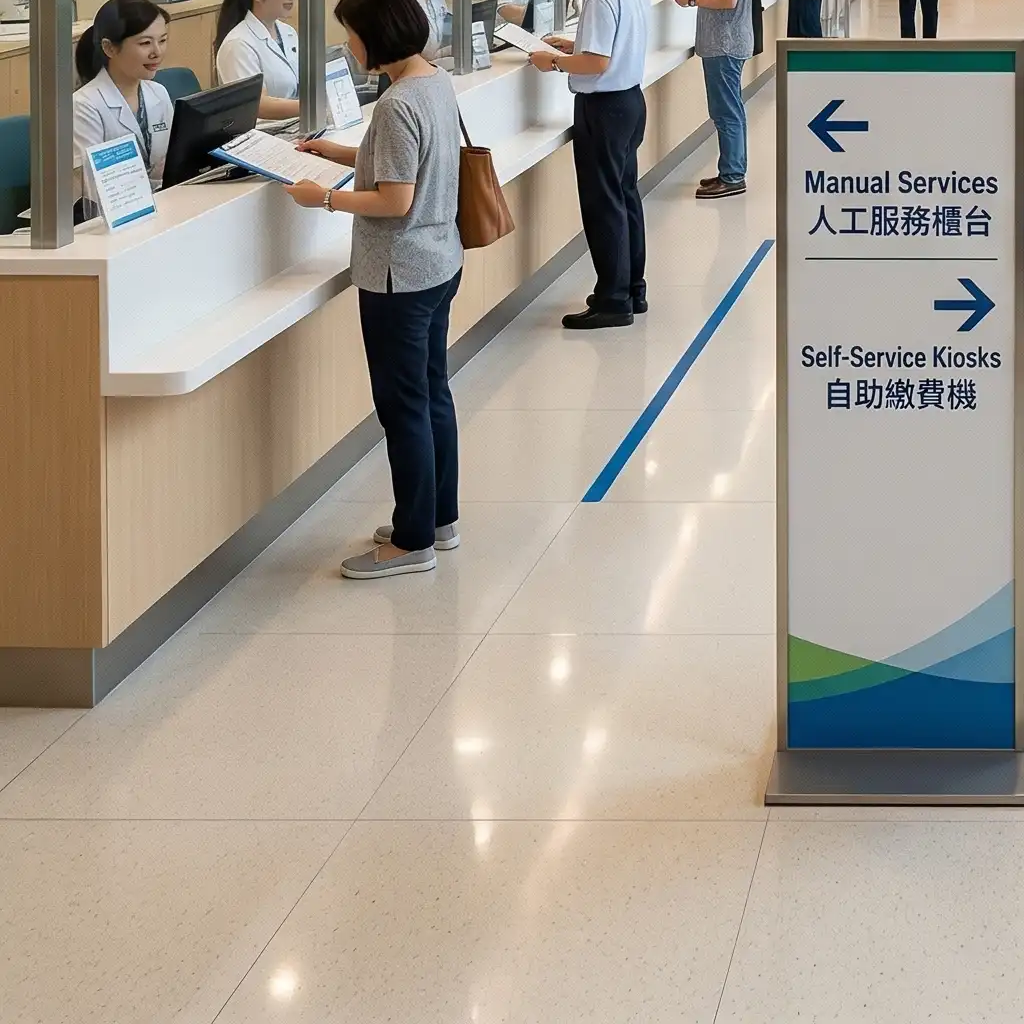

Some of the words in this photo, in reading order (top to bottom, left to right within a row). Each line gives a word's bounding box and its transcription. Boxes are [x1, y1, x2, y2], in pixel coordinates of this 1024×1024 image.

[805, 169, 890, 195] Manual
[897, 170, 999, 195] Services
[807, 204, 992, 238] 人工服務櫃台
[801, 344, 927, 369] Self-Service
[932, 345, 1002, 369] Kiosks
[826, 377, 977, 411] 自助繳費機
